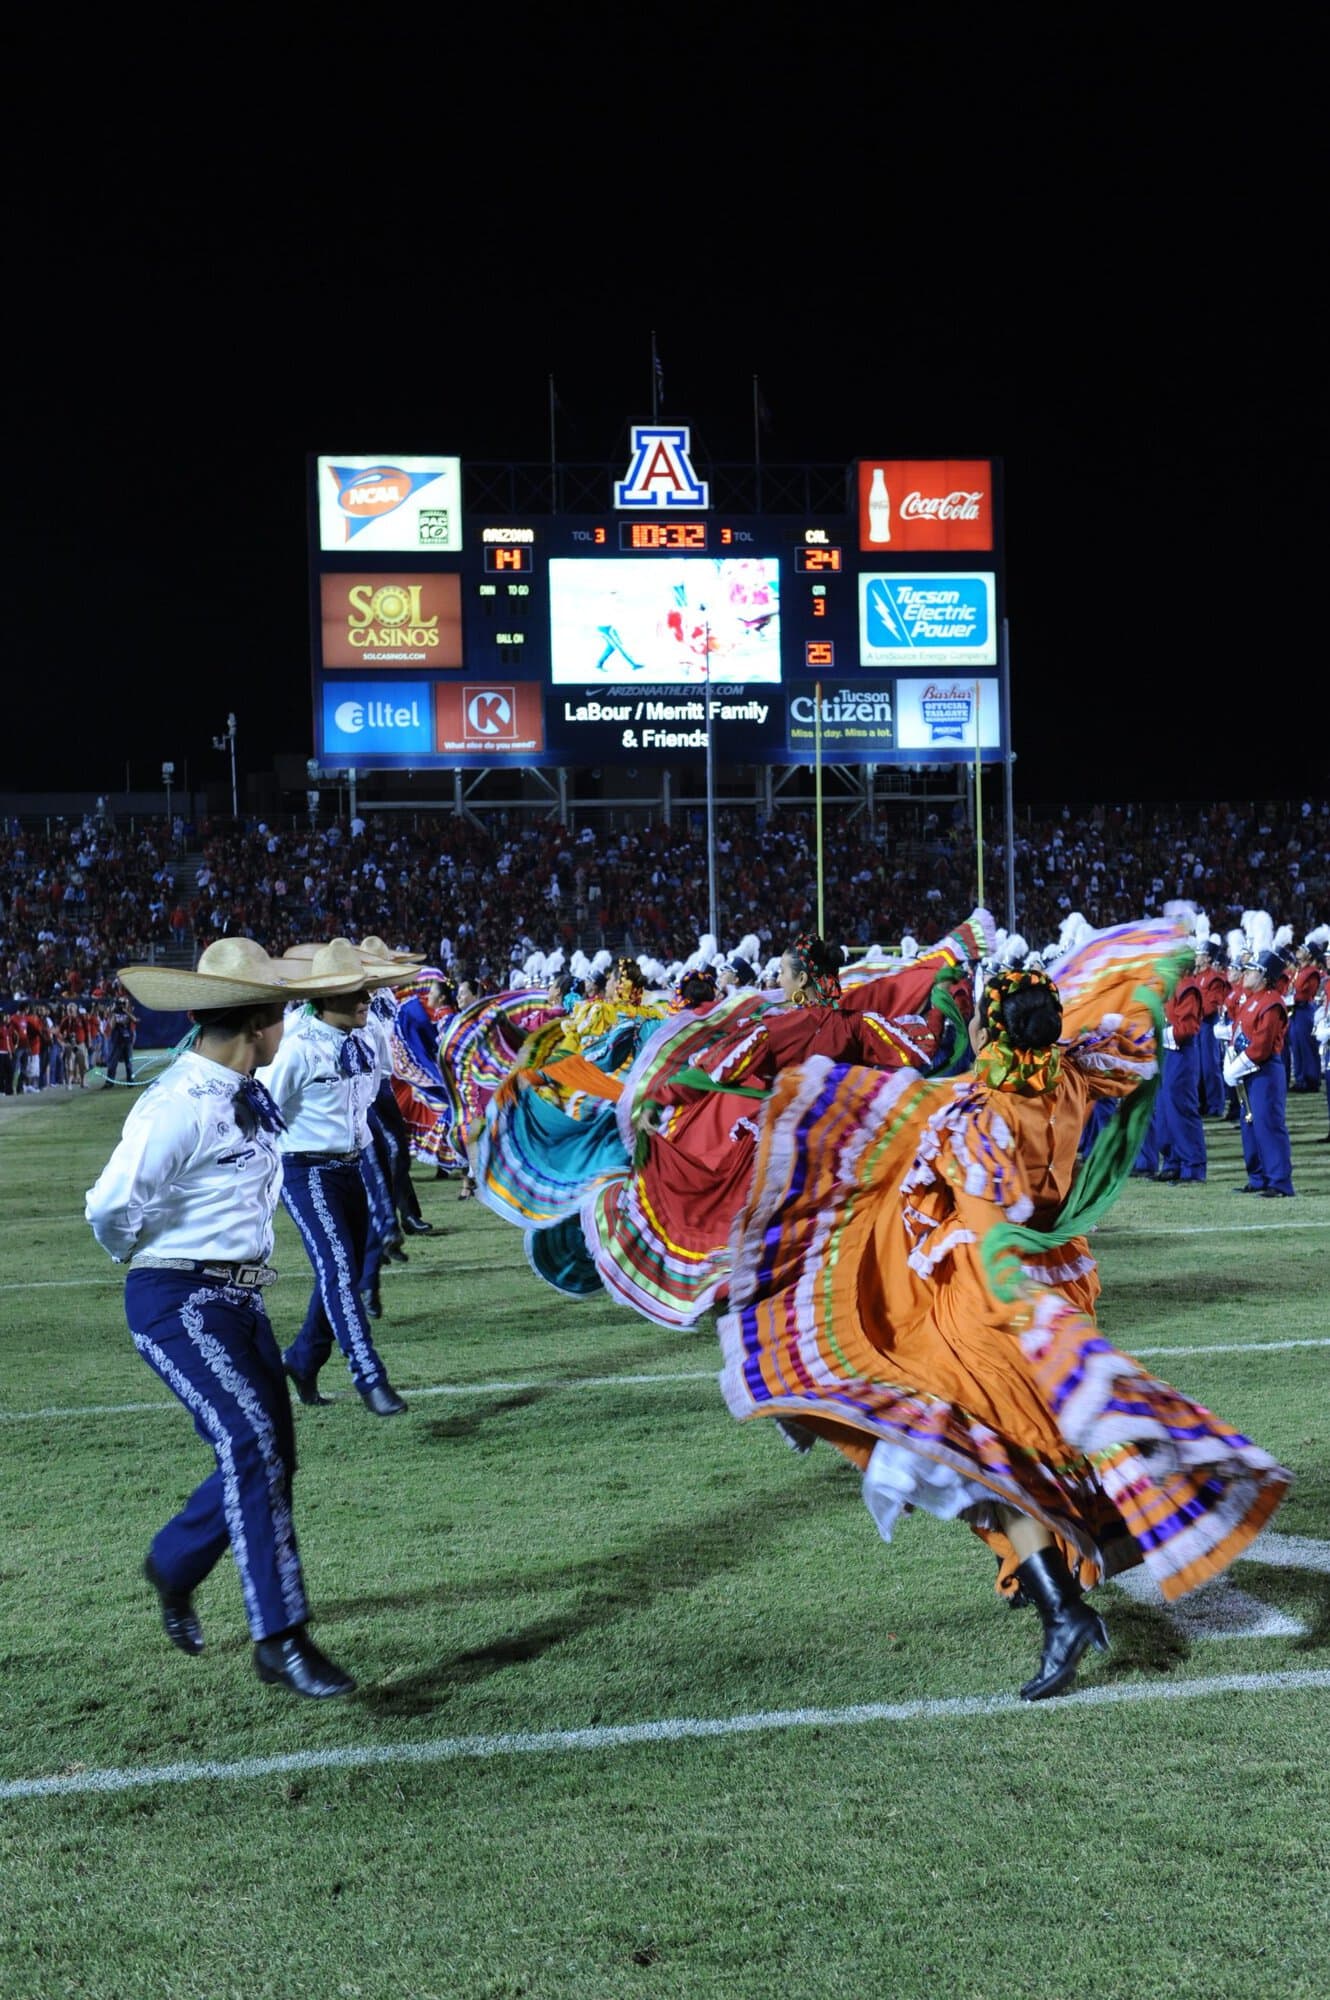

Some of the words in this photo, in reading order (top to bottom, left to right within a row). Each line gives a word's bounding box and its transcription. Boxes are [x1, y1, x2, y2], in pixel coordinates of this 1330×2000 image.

[614, 426, 708, 509] A
[350, 486, 400, 504] NCAA
[899, 491, 984, 520] Coca-Cola
[483, 528, 534, 543] ARIZONA
[571, 531, 592, 541] TOL
[595, 528, 606, 544] 3
[632, 524, 705, 548] 10:32
[721, 528, 732, 544] 3
[734, 531, 754, 541] TOL
[805, 529, 829, 543] CAL
[496, 549, 521, 570] 14
[805, 550, 839, 570] 24
[508, 585, 518, 595] TO
[518, 585, 529, 595] GO
[896, 586, 960, 604] Tucson
[348, 585, 438, 627] SOL
[813, 599, 825, 616] 3
[903, 604, 976, 620] Electric
[348, 628, 440, 647] CASINOS
[911, 621, 976, 638] Power
[808, 643, 832, 664] 25
[607, 686, 744, 696] ARIZONAATHLETICS.COM
[839, 690, 889, 702] Tucson
[565, 702, 632, 721] LaBour
[634, 703, 644, 721] /
[646, 702, 704, 721] Merritt
[709, 702, 769, 724] Family
[790, 697, 892, 722] Citizen
[924, 702, 968, 710] OFFICIAL
[622, 730, 638, 748] &
[642, 730, 710, 748] Friends
[791, 729, 814, 738] Miss
[823, 729, 843, 738] day.
[844, 729, 867, 737] Miss
[877, 729, 892, 737] lot.
[444, 742, 465, 750] What
